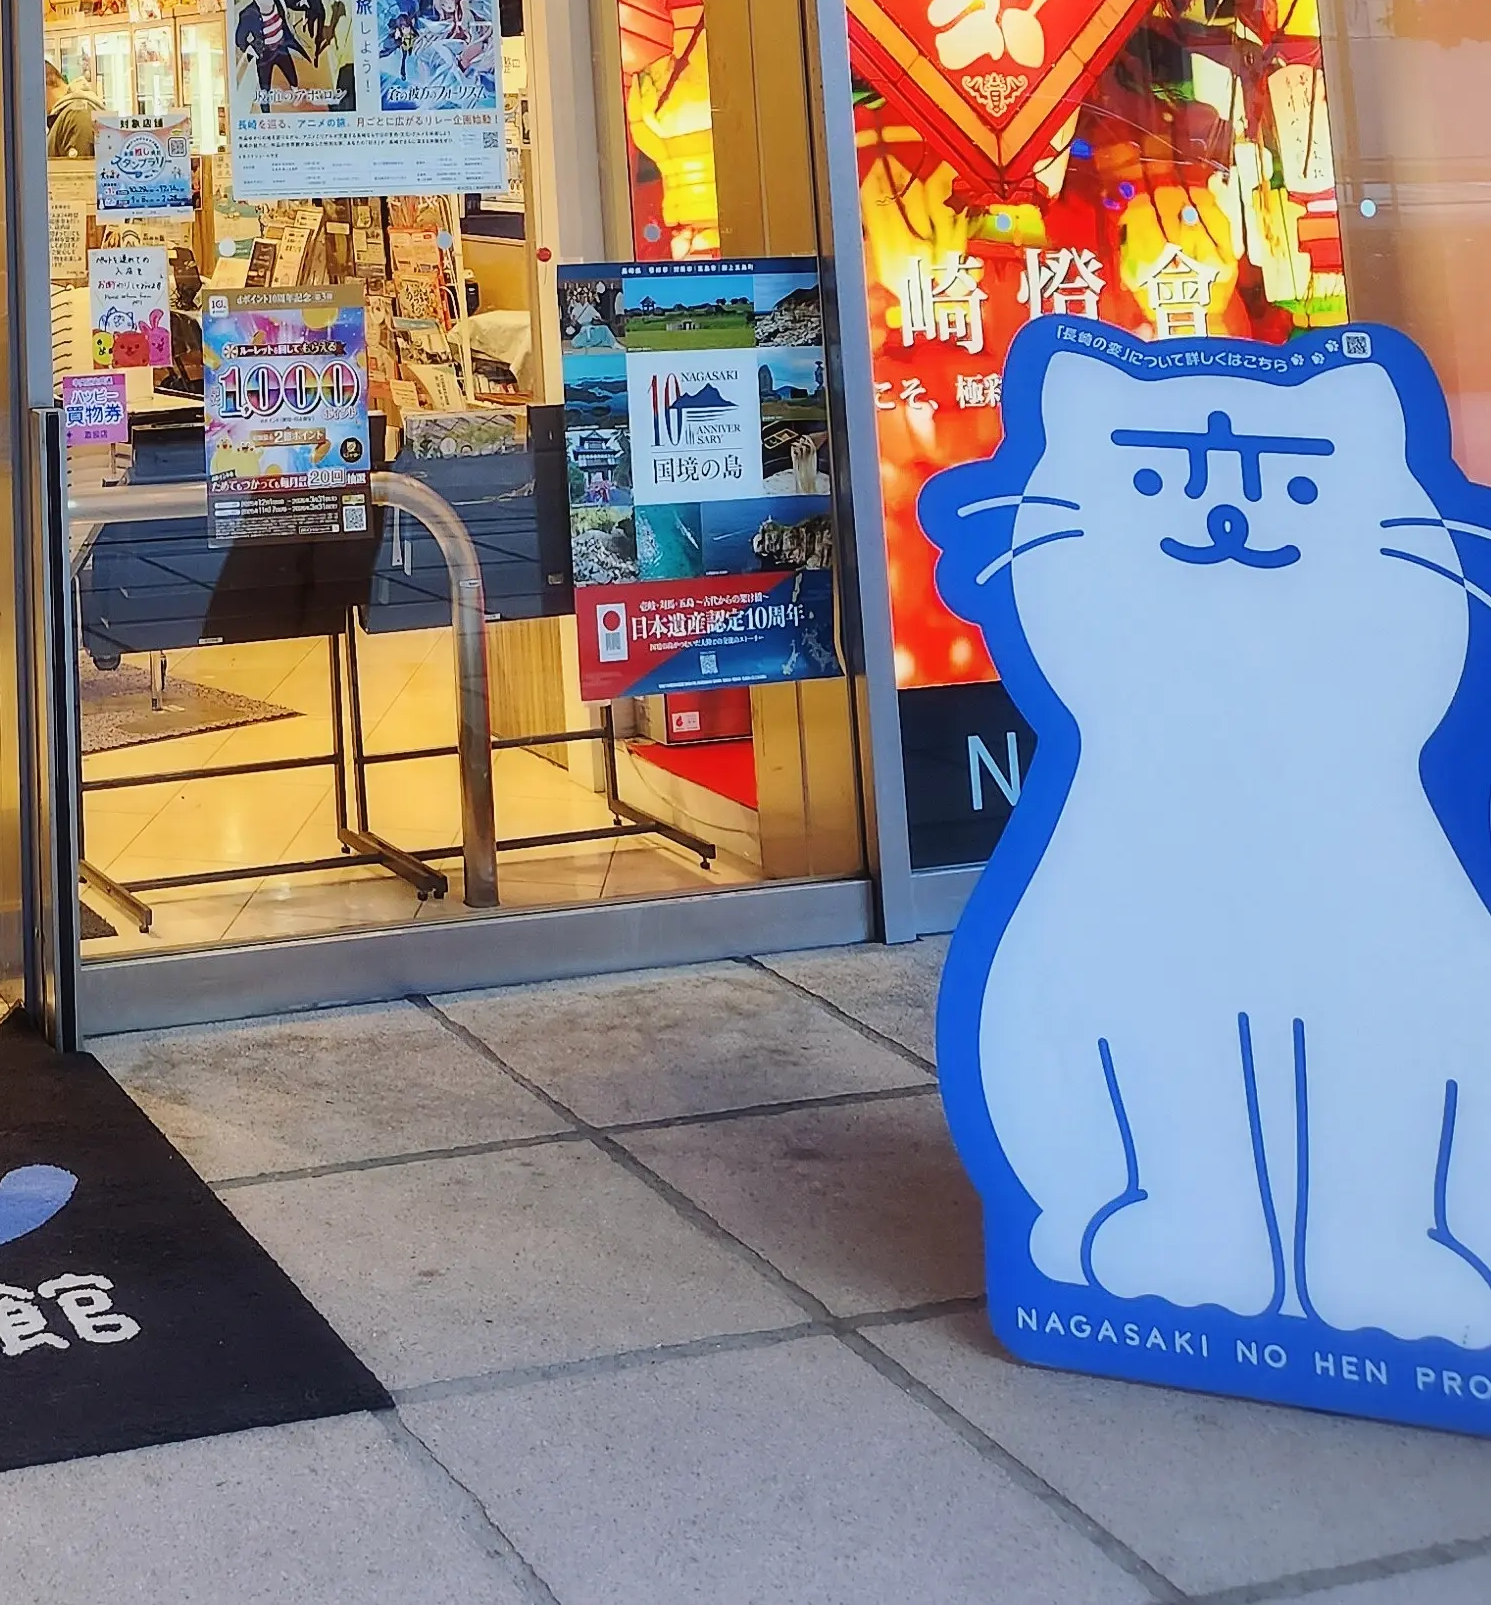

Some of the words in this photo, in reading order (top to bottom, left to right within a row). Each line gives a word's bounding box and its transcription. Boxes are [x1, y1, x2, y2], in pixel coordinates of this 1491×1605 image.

[1055, 325, 1288, 374] 「長崎の変」について詳しくはこちら
[681, 369, 739, 382] NAGASAKI
[71, 388, 119, 404] ハッピー
[218, 361, 361, 420] 1,000
[66, 404, 124, 427] 買物券
[696, 423, 741, 436] ANNIVER
[696, 434, 724, 446] SARY
[652, 454, 743, 484] 国境の島
[631, 604, 805, 641] 日本遺産認定10周年
[1016, 1305, 1209, 1358] NAGASAKI
[1235, 1340, 1288, 1369] NO
[1313, 1351, 1389, 1386] HEN
[1416, 1365, 1491, 1400] PRO
